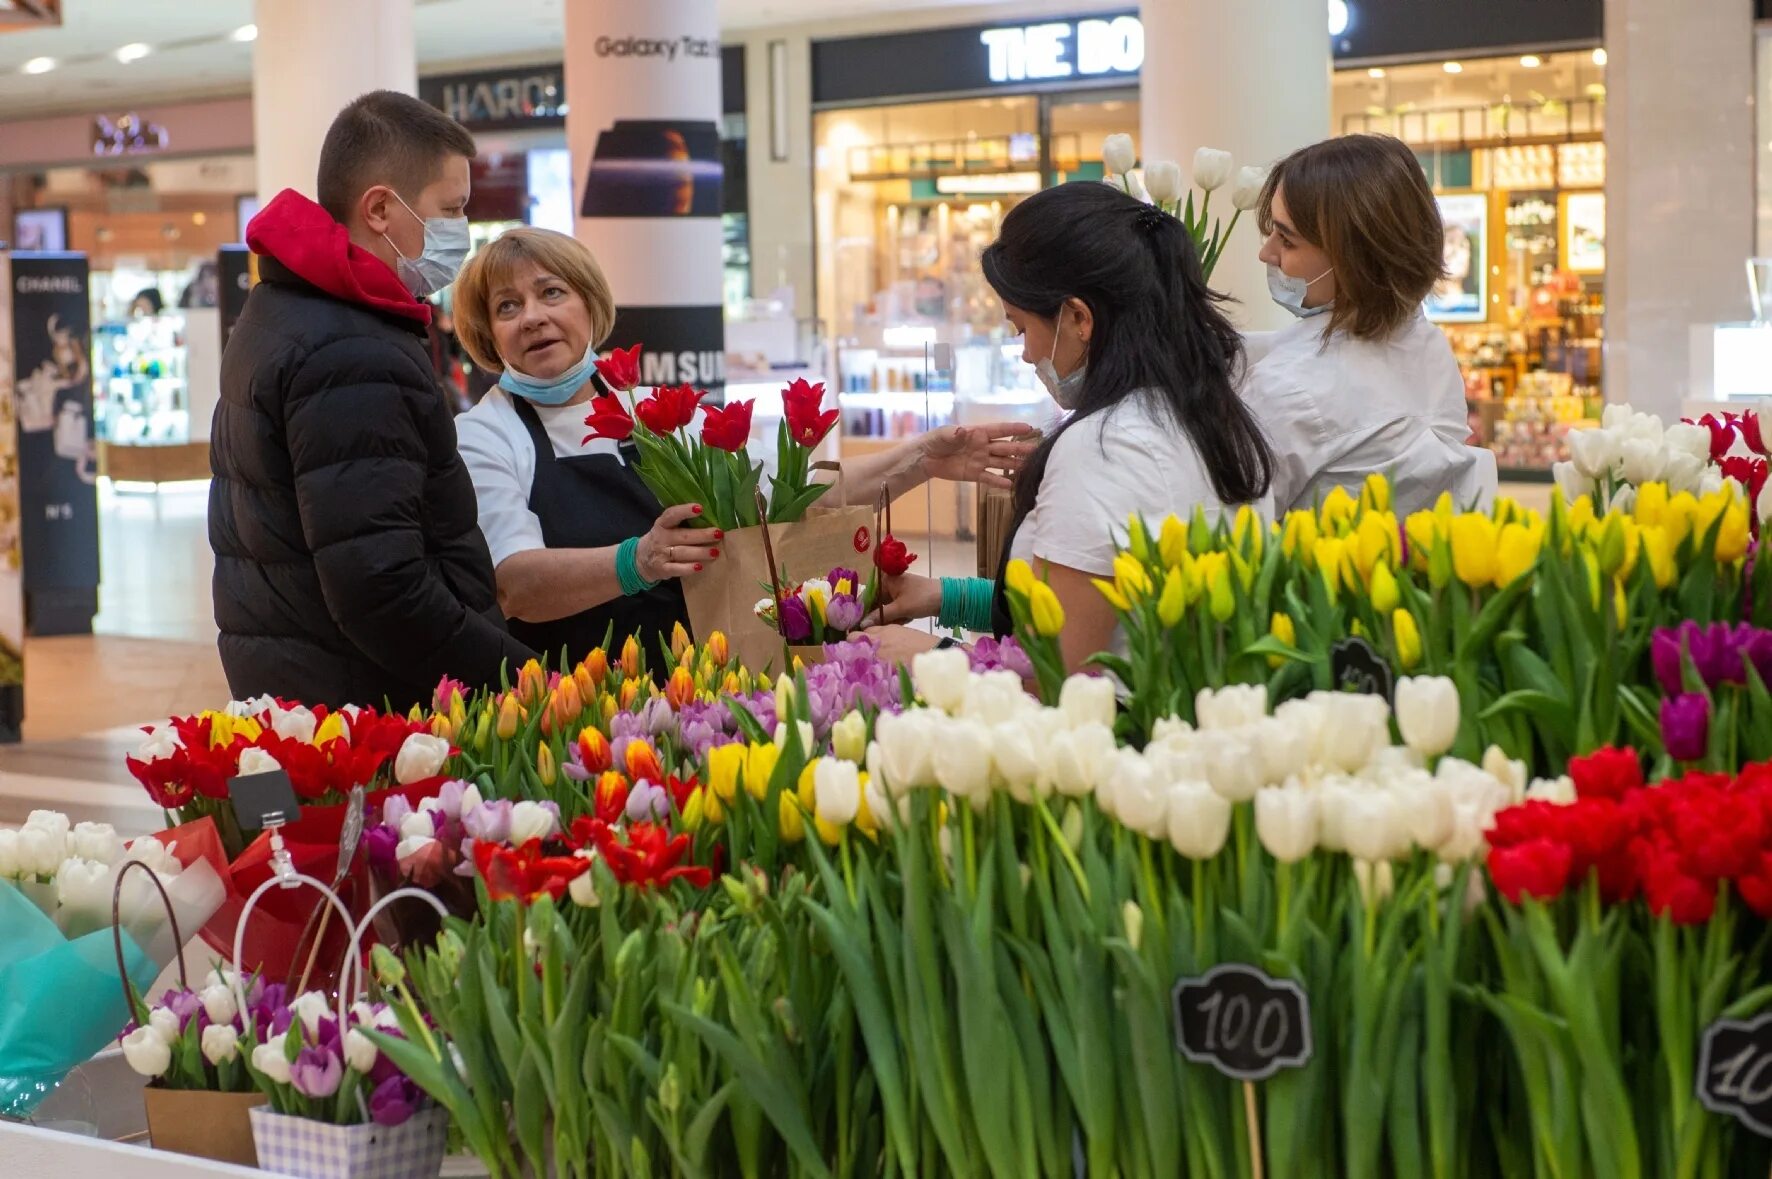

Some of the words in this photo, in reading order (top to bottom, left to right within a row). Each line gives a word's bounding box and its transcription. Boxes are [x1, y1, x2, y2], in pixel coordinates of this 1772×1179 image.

[593, 36, 678, 62] Galaxy
[980, 23, 1072, 82] THE
[1197, 991, 1289, 1057] 100
[1712, 1043, 1772, 1104] 10
